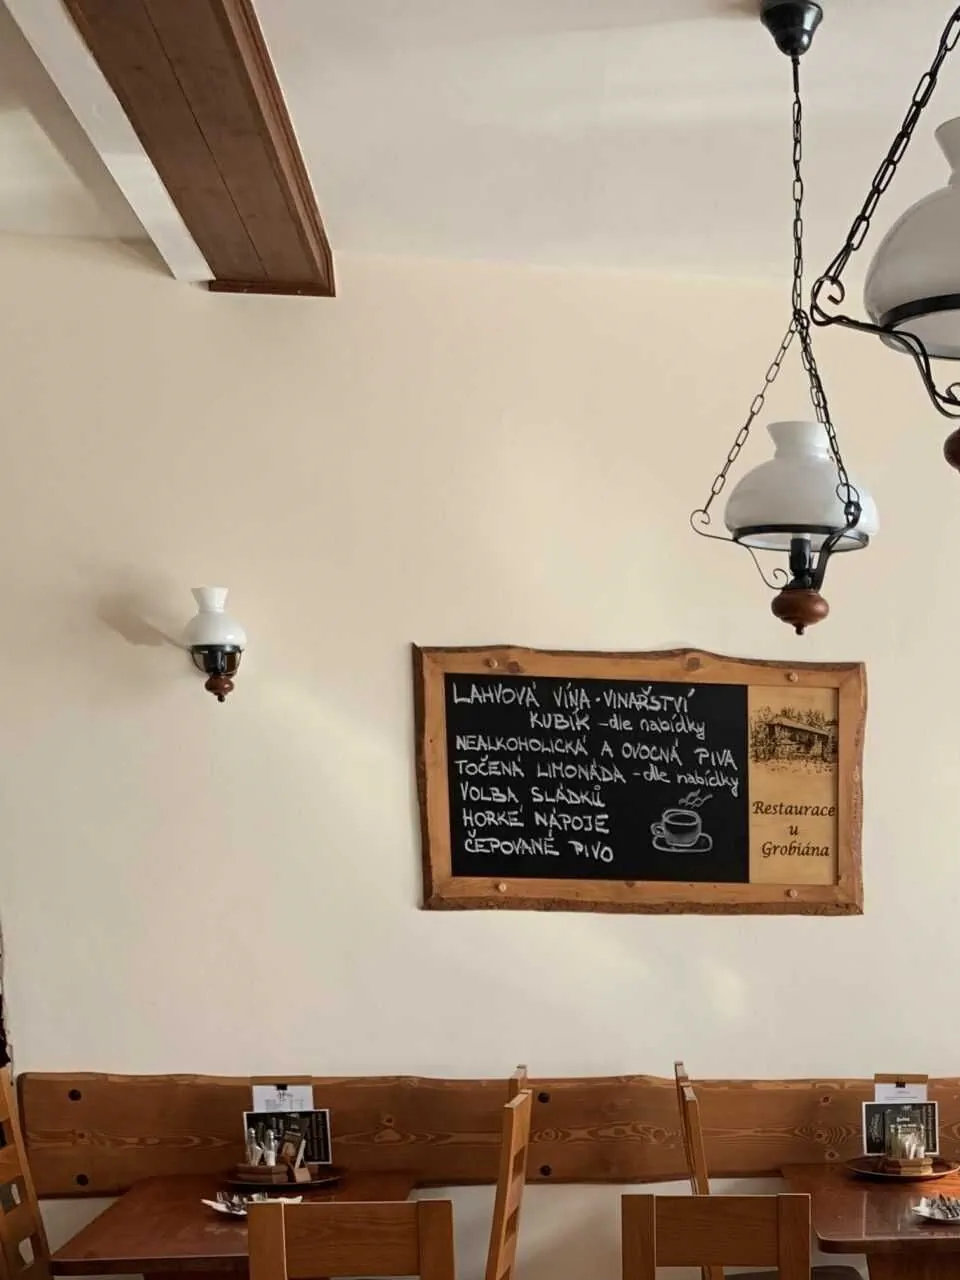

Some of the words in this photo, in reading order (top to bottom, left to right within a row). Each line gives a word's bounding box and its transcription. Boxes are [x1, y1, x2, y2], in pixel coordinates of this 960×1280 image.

[453, 681, 540, 708] LAHVOVÁ
[530, 707, 590, 731] KUBÍK
[640, 713, 705, 740] nabídky
[456, 734, 589, 756] NEALKOHOLICKÁ
[601, 740, 613, 757] A
[621, 738, 683, 766] OVOCNÁ
[694, 748, 738, 771] PIVA
[454, 754, 525, 778] TOČENÁ
[537, 758, 627, 783] LIMONÁDA
[677, 769, 739, 798] nabídky
[460, 781, 519, 803] VOLBA
[462, 804, 524, 827] HORKÉ
[534, 807, 610, 834] NÁPOJE
[752, 800, 836, 817] Restaurace
[788, 825, 799, 836] u
[464, 829, 560, 856] ČEPOVANÉ
[568, 840, 614, 863] PIVO
[761, 840, 830, 858] Grobiána
